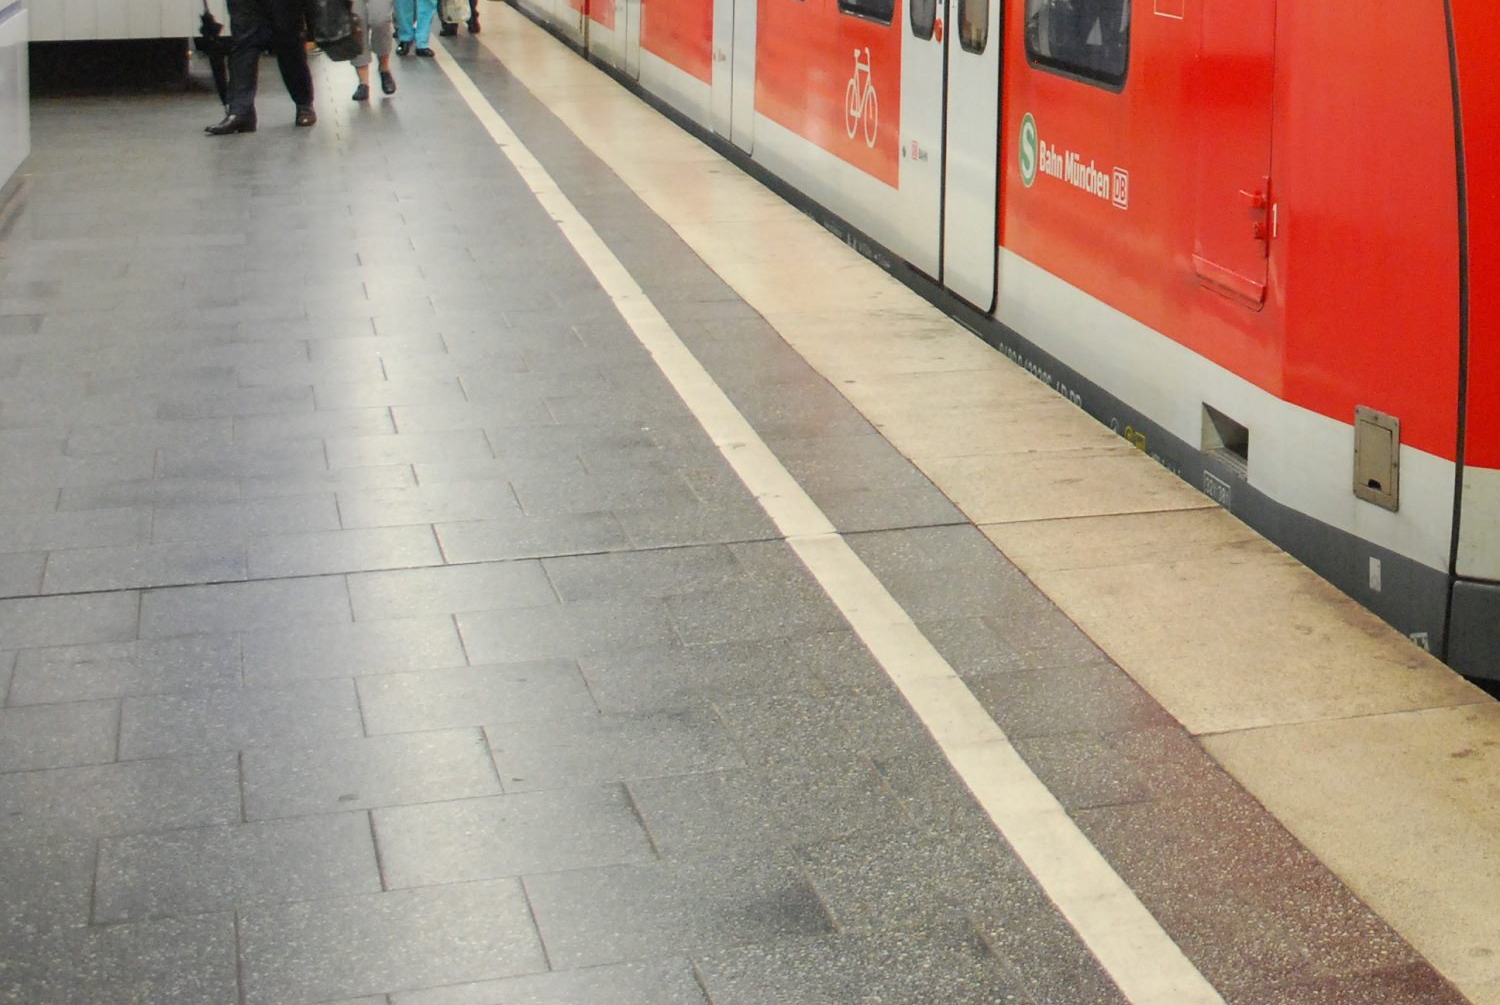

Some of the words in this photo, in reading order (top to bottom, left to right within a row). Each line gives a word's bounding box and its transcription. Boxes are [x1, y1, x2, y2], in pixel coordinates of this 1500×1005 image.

[1021, 118, 1036, 183] S
[1040, 140, 1063, 180] Bahn
[1065, 150, 1110, 200] München
[1114, 171, 1127, 205] DB
